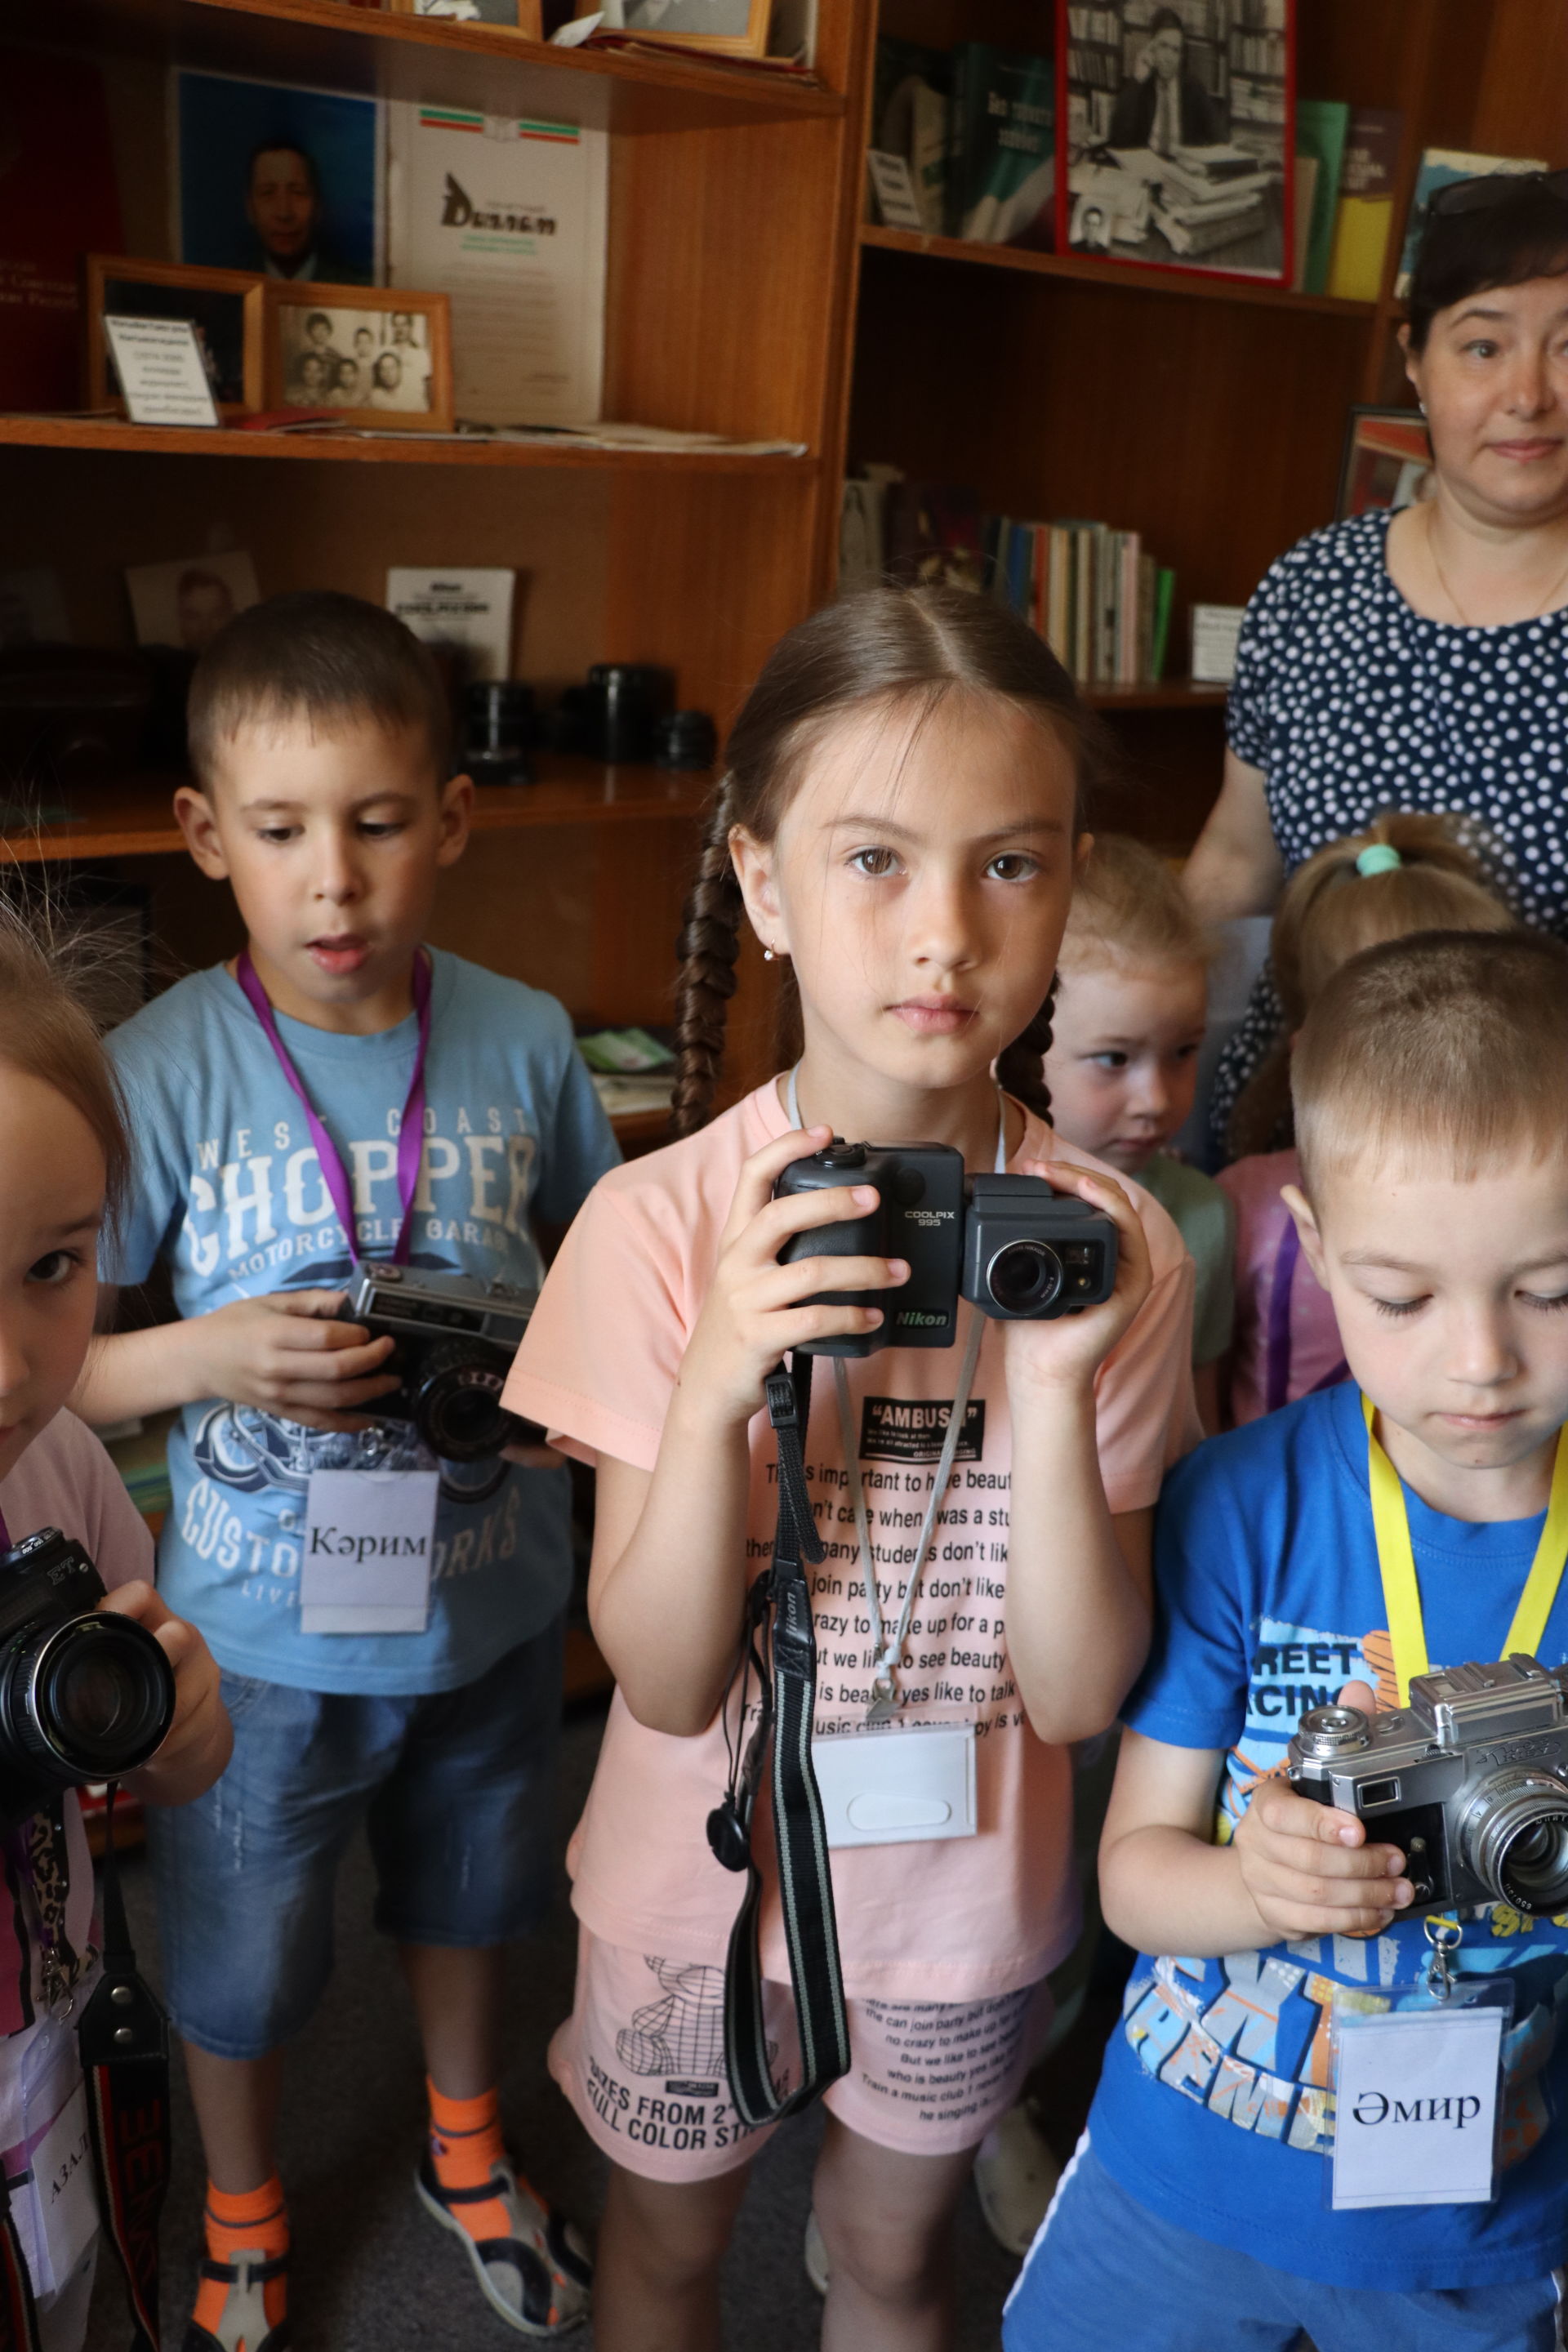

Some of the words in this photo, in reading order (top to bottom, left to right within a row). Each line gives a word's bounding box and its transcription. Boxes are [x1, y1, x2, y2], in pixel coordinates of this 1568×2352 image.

[198, 1116, 327, 1171] WES
[905, 1210, 955, 1219] COOLPIX
[918, 1218, 942, 1227] 995
[896, 1312, 947, 1325] Nikon
[820, 1463, 899, 1491] imprtant
[905, 1472, 921, 1492] to
[926, 1471, 961, 1490] hve
[836, 1506, 874, 1526] cae
[880, 1508, 923, 1528] when
[937, 1508, 968, 1526] was
[973, 1508, 982, 1525] a
[310, 1526, 427, 1563] Кәрим
[869, 1544, 937, 1563] studens
[942, 1540, 985, 1561] don't
[811, 1570, 843, 1596] join
[848, 1580, 892, 1603] paty
[929, 1577, 971, 1598] don't
[976, 1576, 1005, 1599] like
[854, 1615, 871, 1633] to
[928, 1617, 947, 1637] up
[951, 1612, 975, 1631] for
[979, 1618, 988, 1633] a
[834, 1652, 858, 1668] we
[919, 1651, 946, 1668] see
[951, 1647, 1007, 1673] beauty
[819, 1681, 833, 1701] is
[902, 1686, 930, 1708] yes
[933, 1681, 964, 1702] like
[970, 1684, 986, 1703] to
[991, 1679, 1015, 1702] talk
[995, 1712, 1008, 1729] is
[886, 2017, 908, 2028] can
[910, 2017, 933, 2033] join
[935, 2016, 964, 2032] party
[885, 2034, 901, 2046] no
[903, 2038, 936, 2050] crazy
[939, 2036, 951, 2047] to
[953, 2027, 982, 2044] make
[900, 2053, 921, 2065] But
[924, 2057, 942, 2066] we
[944, 2051, 964, 2065] like
[966, 2048, 978, 2059] to
[862, 2071, 889, 2094] Train
[891, 2089, 898, 2098] a
[901, 2091, 938, 2103] music
[940, 2087, 964, 2102] club
[887, 2069, 912, 2083] who
[915, 2073, 925, 2085] is
[929, 2071, 966, 2085] beauty
[587, 2078, 621, 2132] FULL
[628, 2118, 706, 2149] COLOR
[637, 2095, 706, 2125] FROM
[919, 2109, 934, 2121] he
[1352, 2091, 1481, 2130] Әмир
